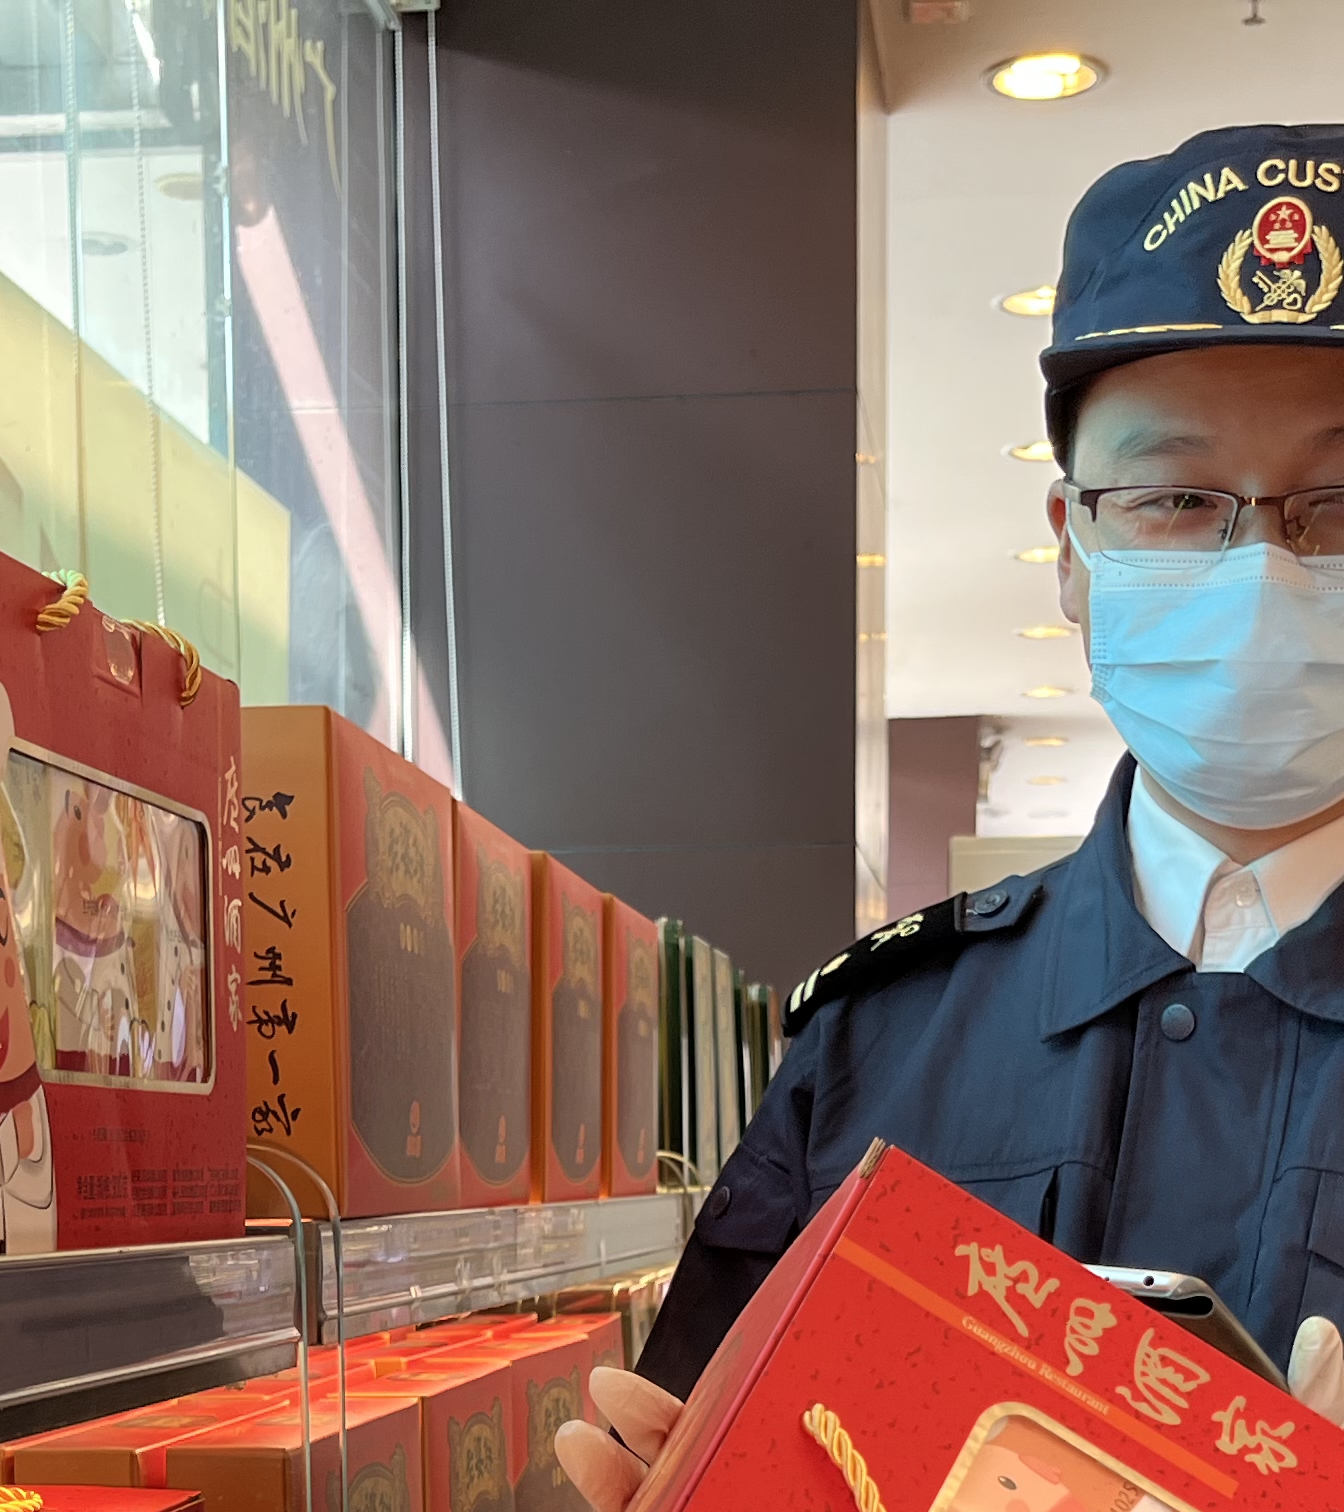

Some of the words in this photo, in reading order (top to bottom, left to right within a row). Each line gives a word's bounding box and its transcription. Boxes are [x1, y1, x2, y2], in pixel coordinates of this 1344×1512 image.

[1143, 167, 1247, 252] CHINA
[961, 1313, 1037, 1371] Guangzhou
[1037, 1362, 1111, 1415] Restaurant
